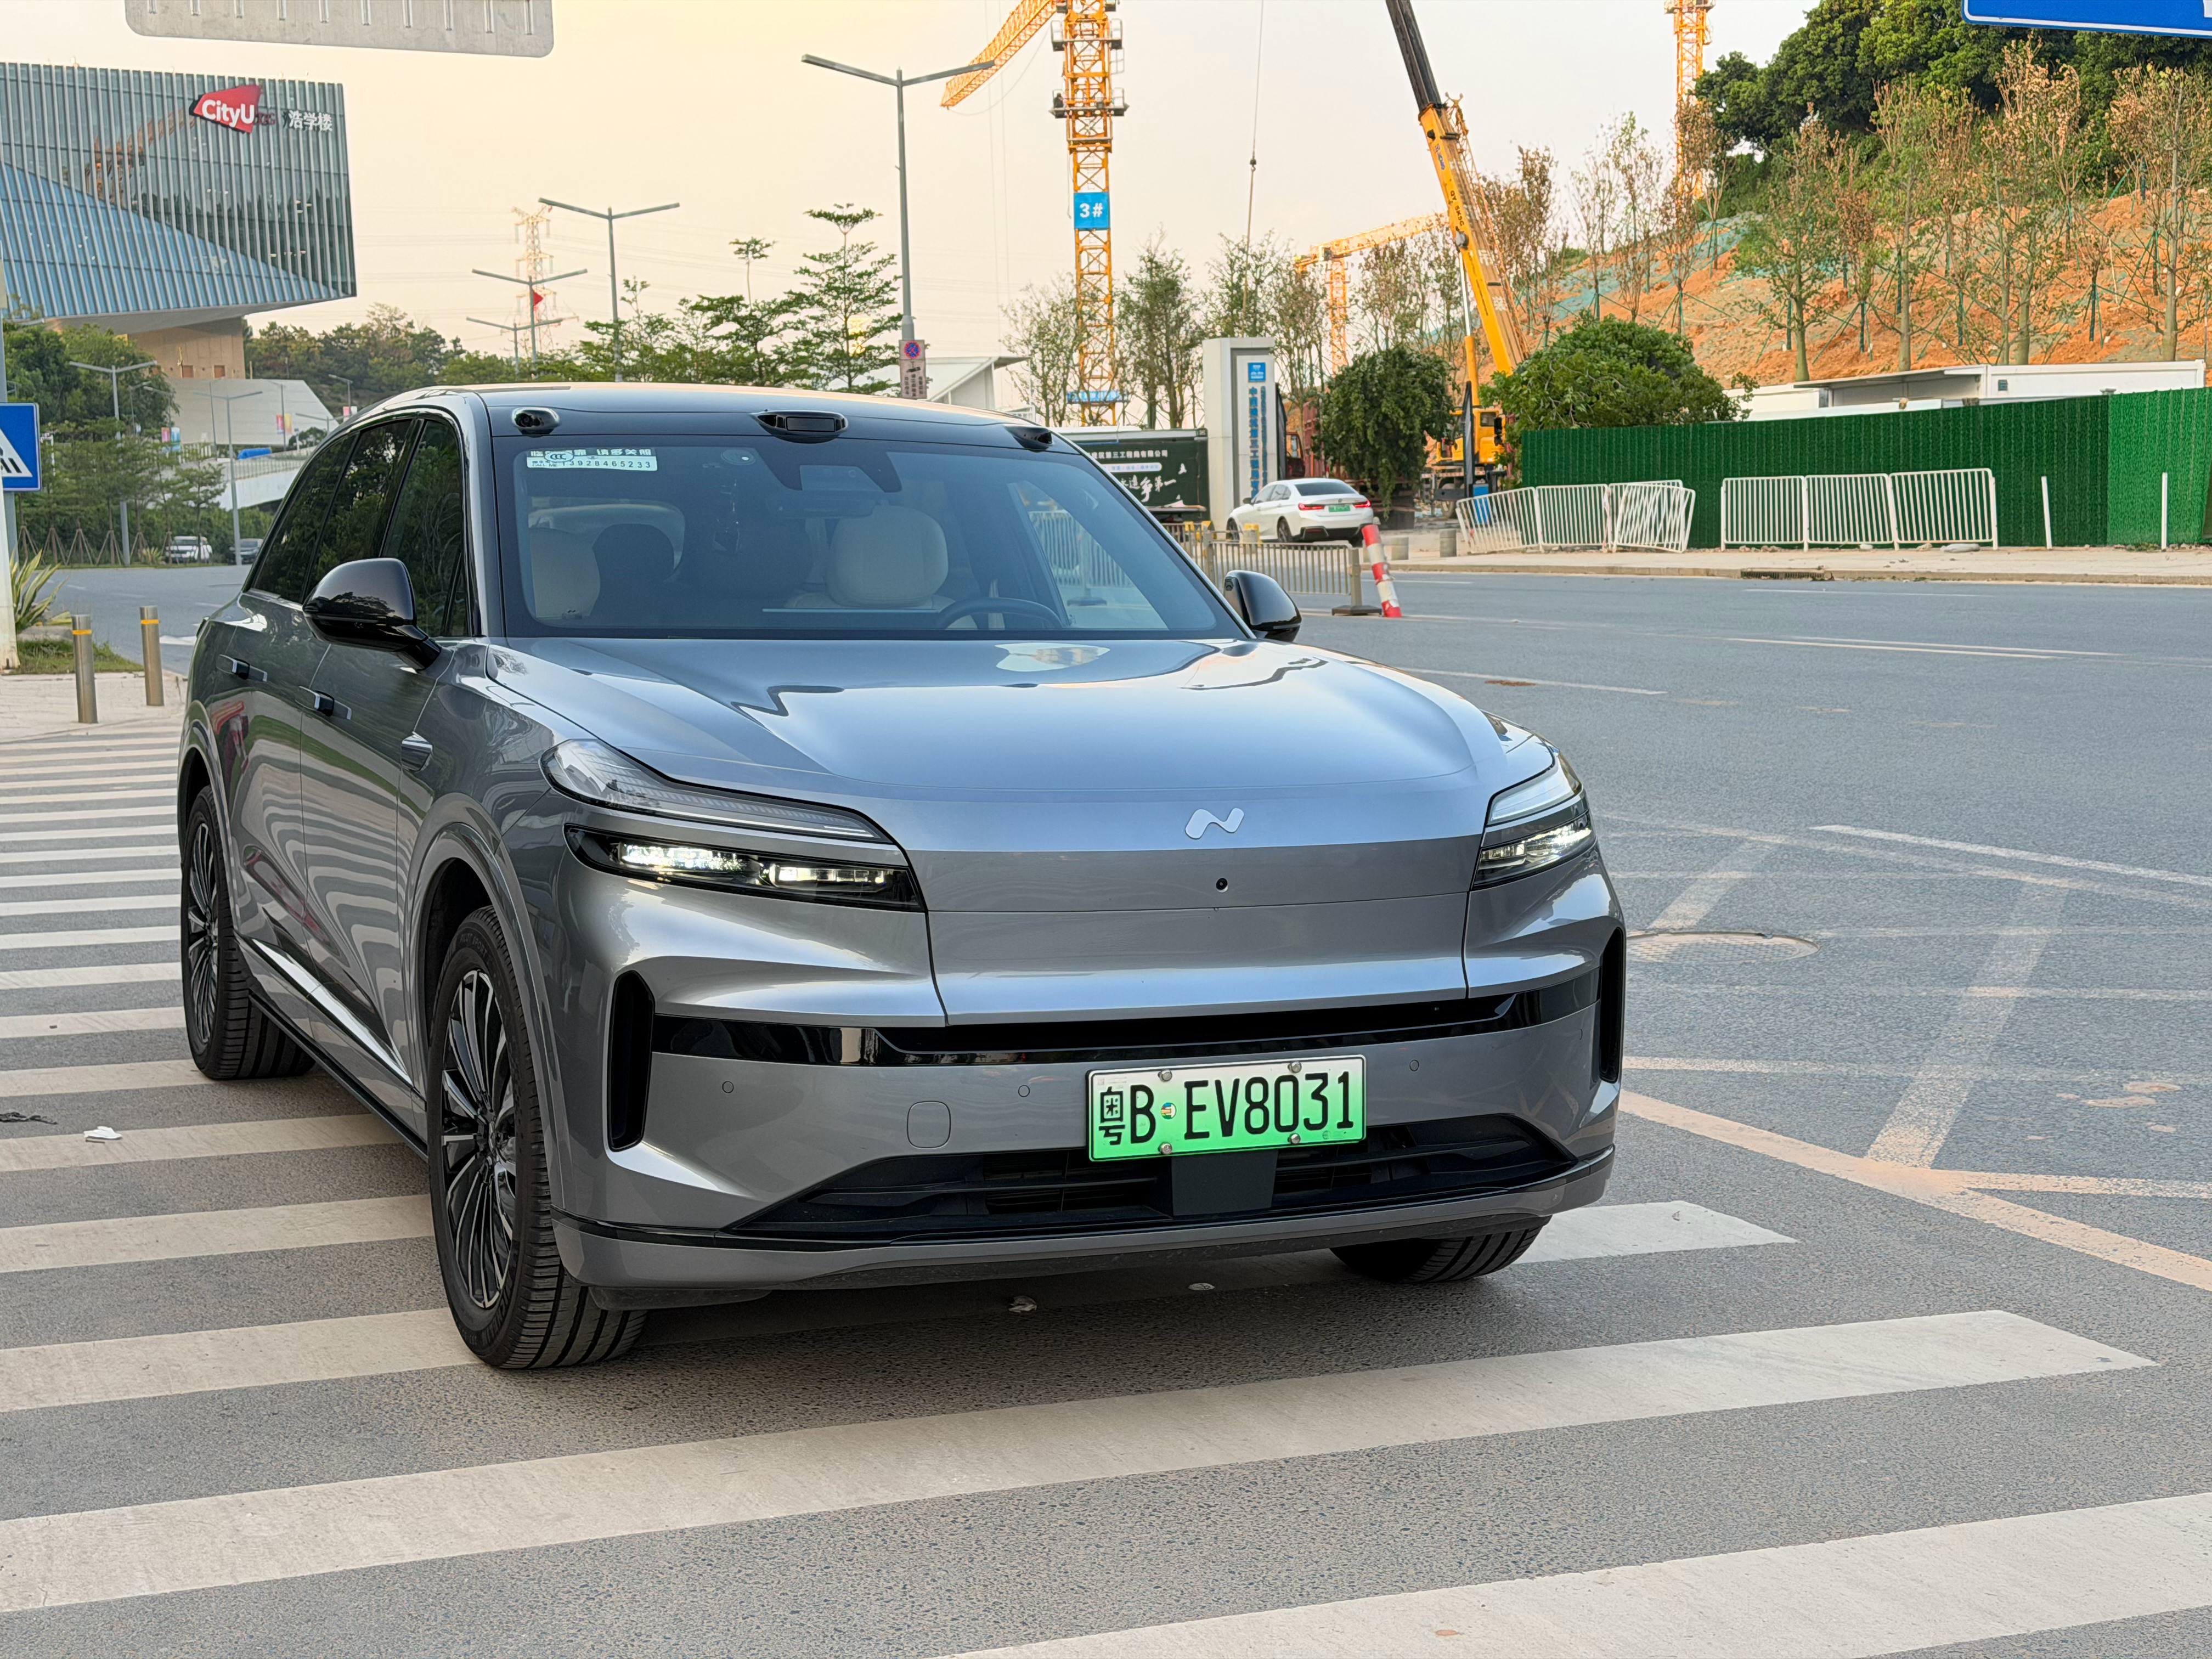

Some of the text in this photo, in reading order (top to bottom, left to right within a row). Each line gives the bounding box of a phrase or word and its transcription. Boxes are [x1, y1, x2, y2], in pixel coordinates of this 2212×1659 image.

[202, 99, 255, 127] CityU
[288, 110, 333, 131] 浩学楼
[1080, 202, 1103, 218] 3#
[1088, 449, 1168, 460] 建筑第三工程局有限公司
[1184, 1071, 1354, 1140] EV8031
